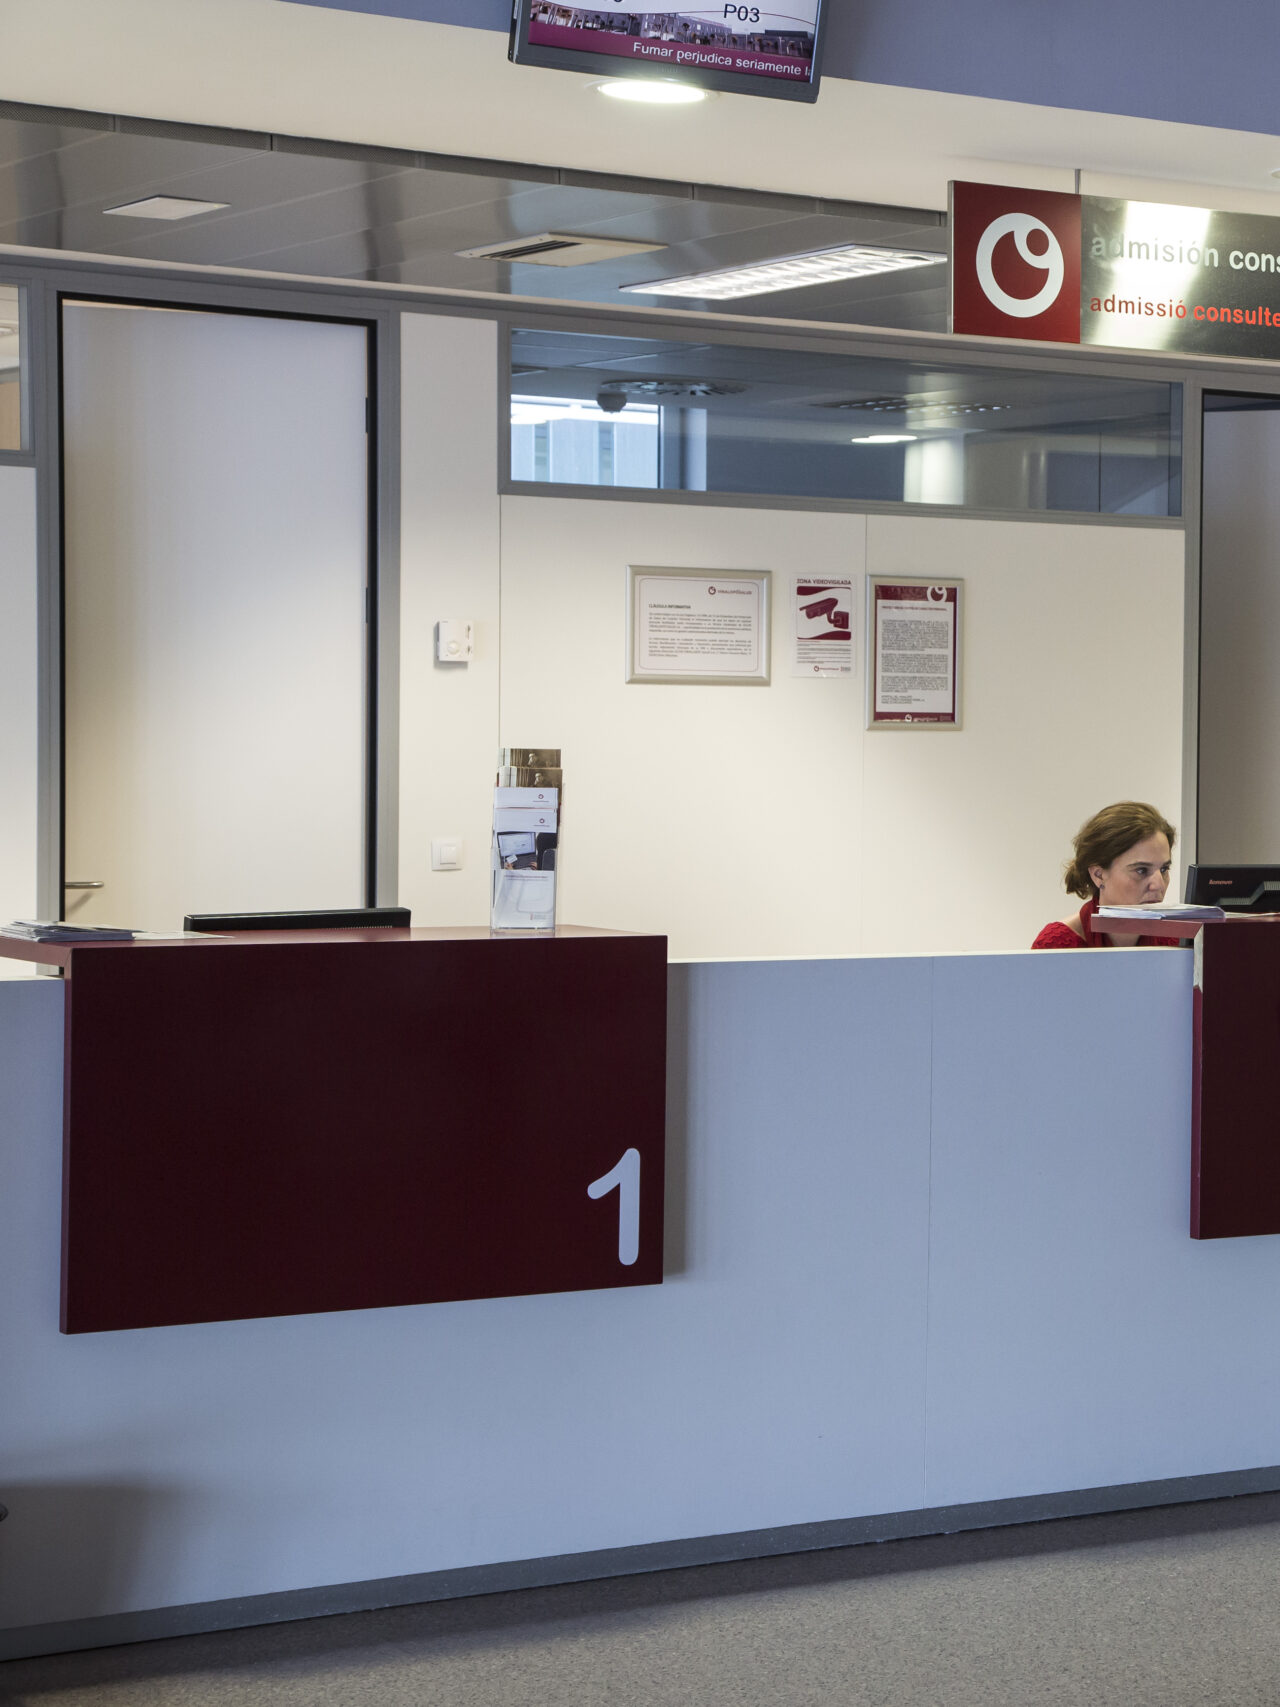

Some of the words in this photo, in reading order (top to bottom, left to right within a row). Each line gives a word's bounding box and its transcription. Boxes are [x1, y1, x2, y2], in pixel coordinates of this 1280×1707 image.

[723, 3, 761, 23] P03
[633, 42, 674, 57] Fumar
[676, 48, 732, 66] perjudica
[736, 58, 802, 75] seriamente
[1091, 232, 1219, 268] admisión
[1090, 293, 1187, 320] admissió
[587, 1147, 641, 1266] 1
